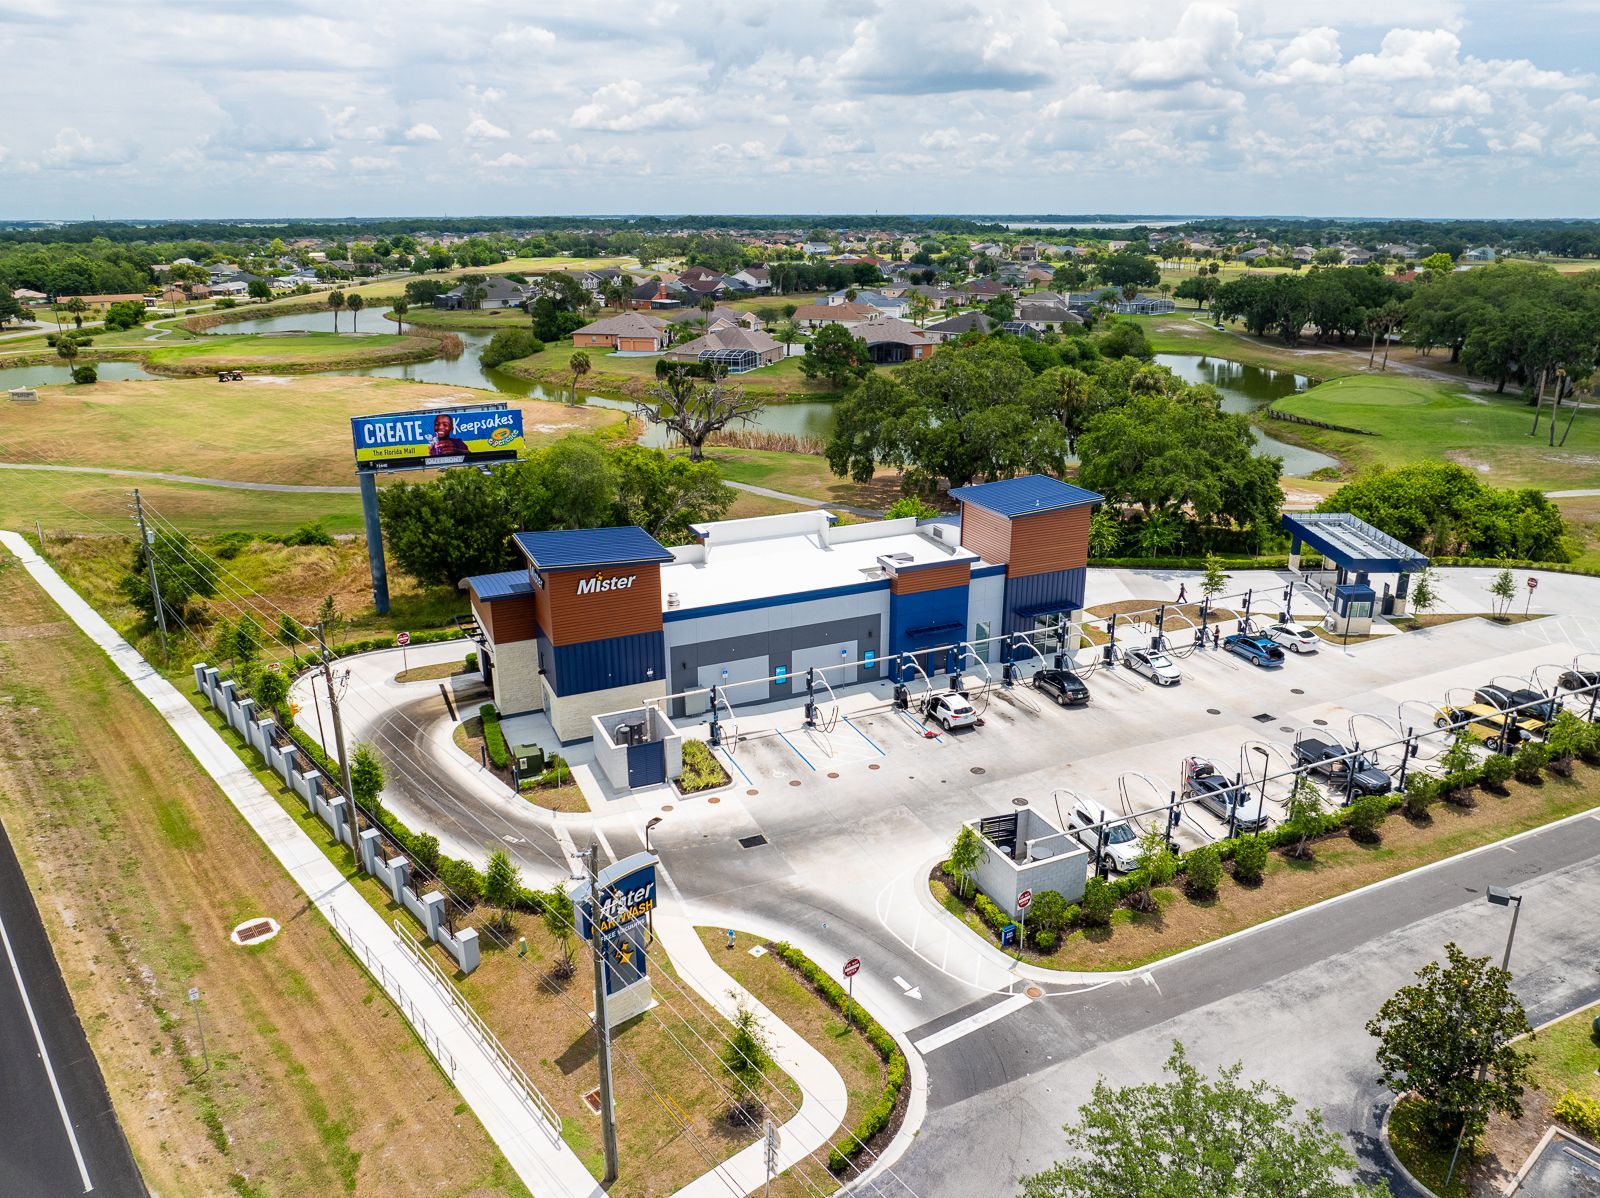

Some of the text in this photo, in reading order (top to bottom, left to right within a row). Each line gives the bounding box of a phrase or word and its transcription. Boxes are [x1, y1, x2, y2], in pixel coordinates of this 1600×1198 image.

[363, 420, 424, 444] CREATE
[452, 413, 514, 435] Keepsakes
[372, 447, 416, 457] The Florida Mall
[576, 574, 637, 595] Mister
[591, 917, 616, 935] AR
